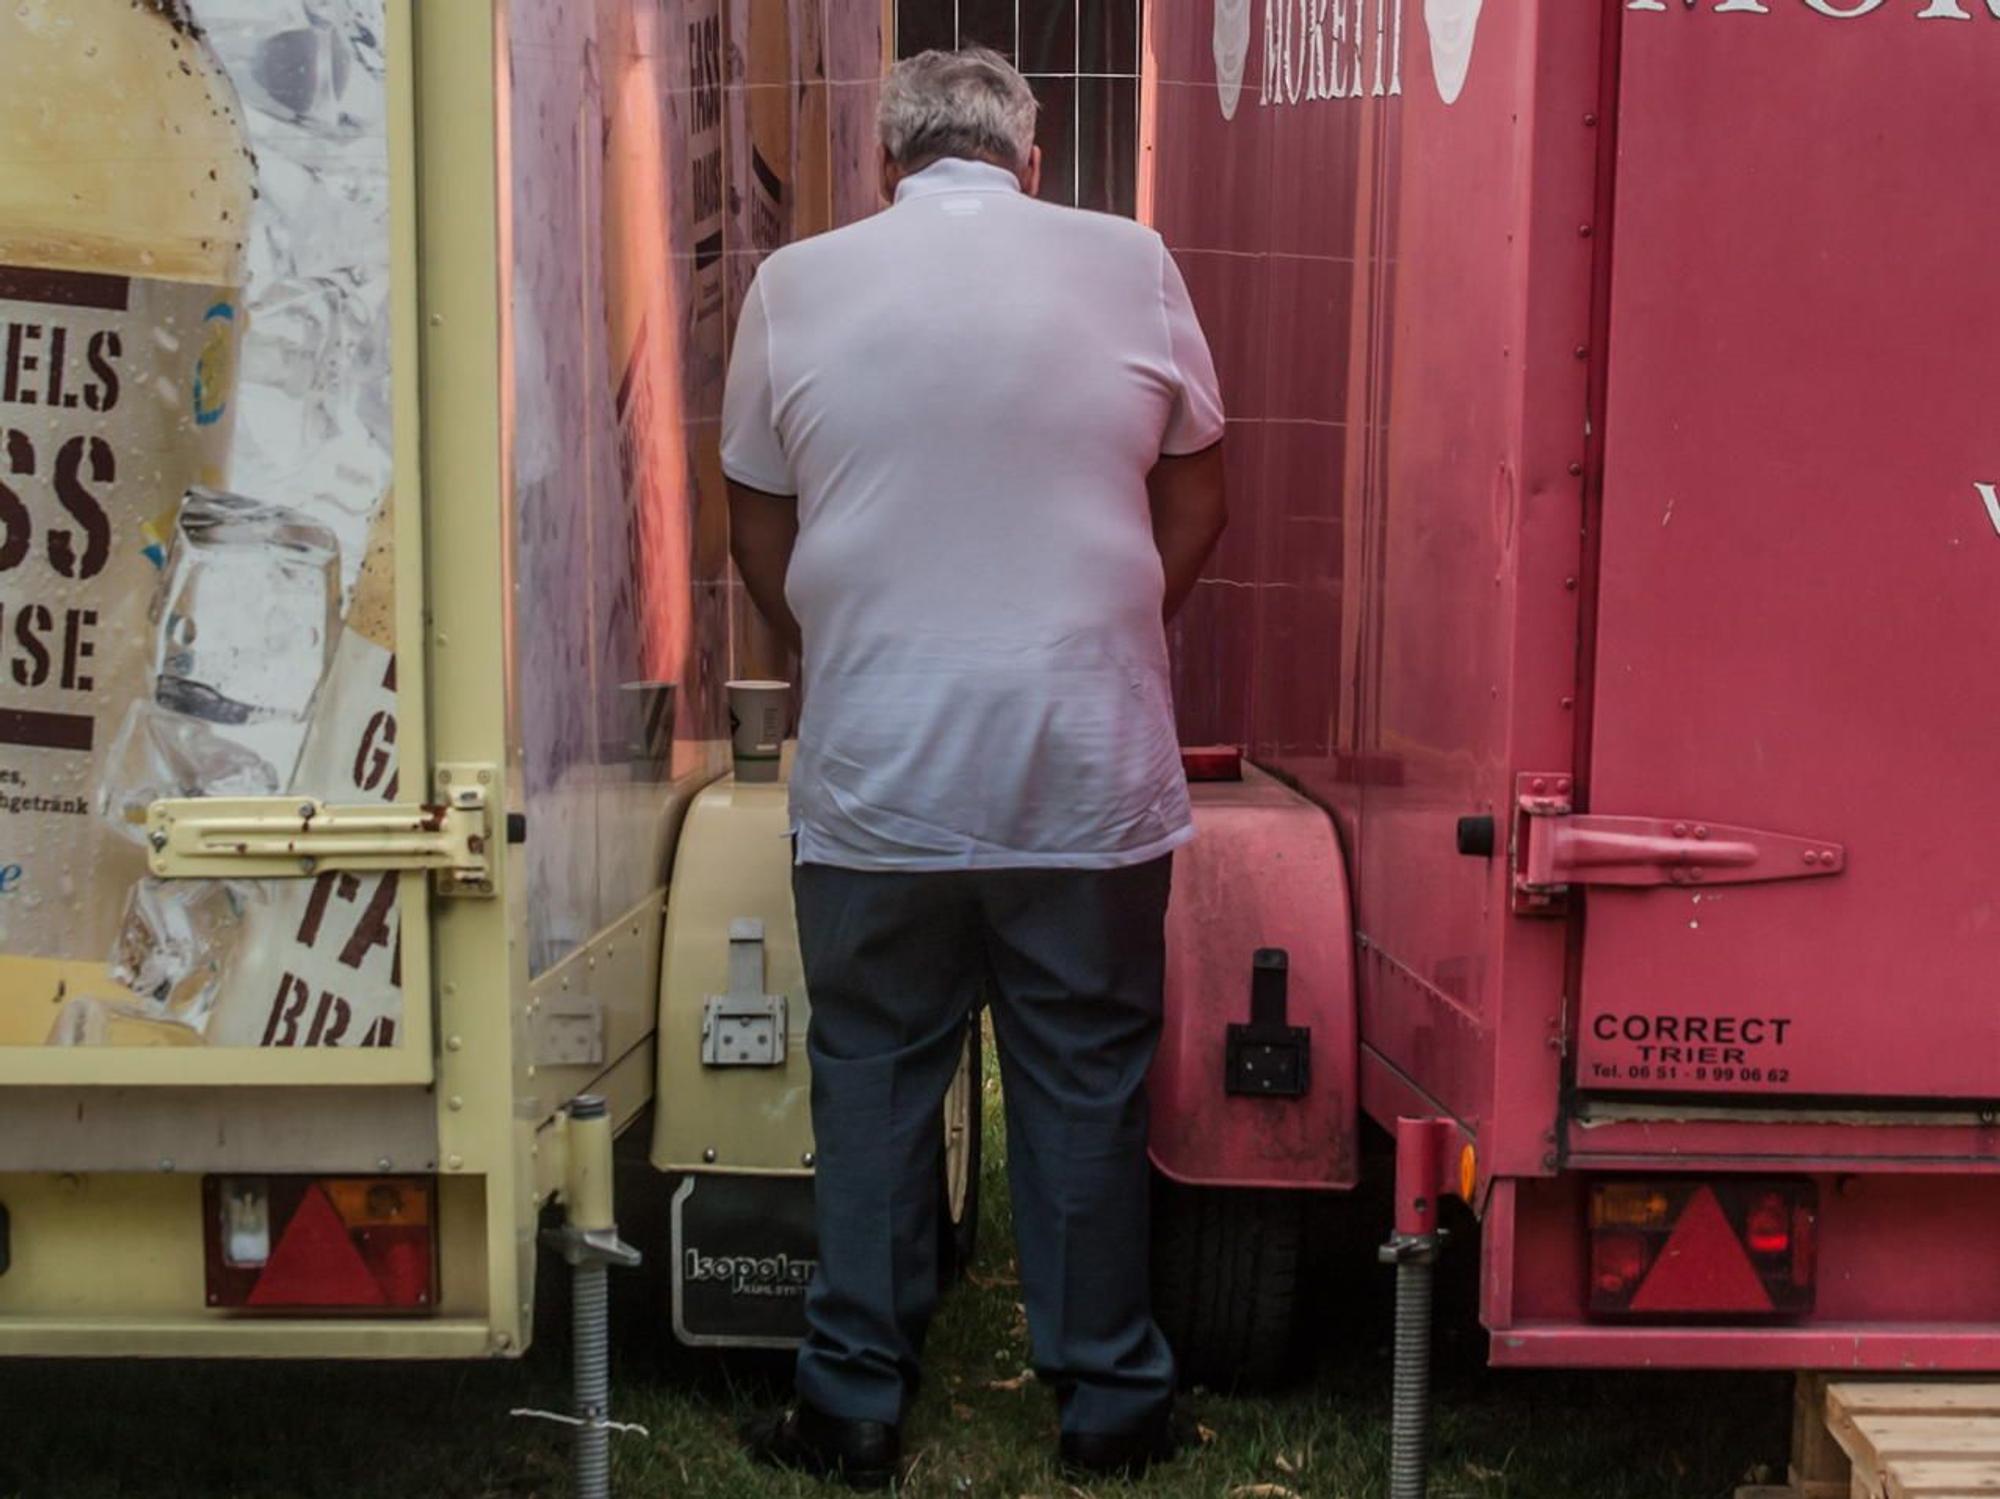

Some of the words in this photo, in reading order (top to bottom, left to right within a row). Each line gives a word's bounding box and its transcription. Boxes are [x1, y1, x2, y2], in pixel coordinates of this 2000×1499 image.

[3, 323, 122, 412] ELS
[1593, 1014, 1791, 1045] CORRECT
[1637, 1045, 1744, 1064] TRIER
[1592, 1063, 1622, 1079] Tel.
[1628, 1065, 1650, 1079] 06
[1656, 1066, 1677, 1079] 51
[1740, 1068, 1762, 1082] 06
